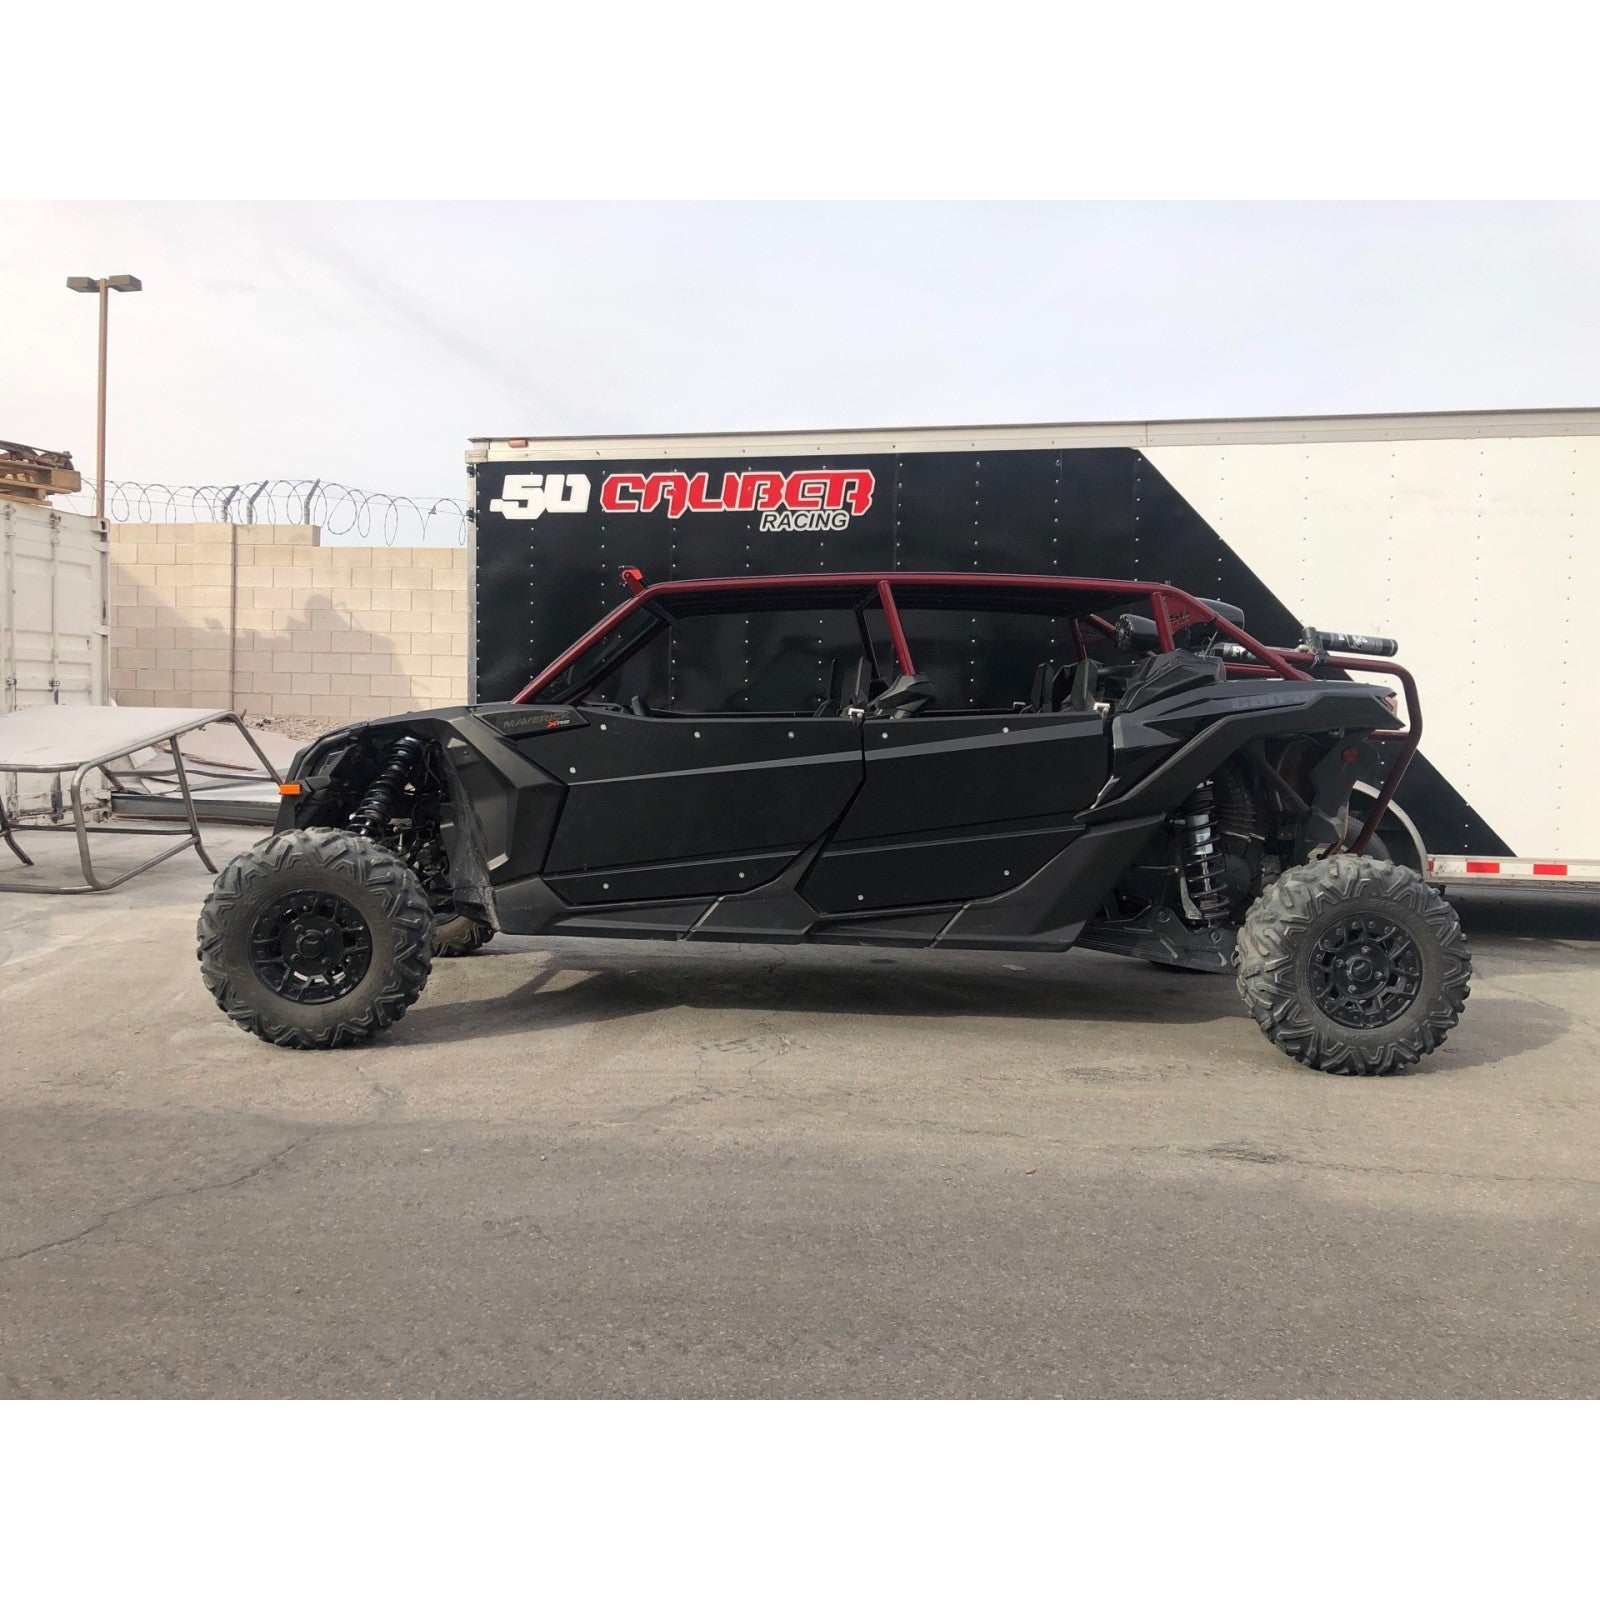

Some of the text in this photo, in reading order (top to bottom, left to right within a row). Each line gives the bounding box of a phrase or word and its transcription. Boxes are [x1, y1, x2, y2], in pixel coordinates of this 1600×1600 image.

[490, 470, 875, 519] .50 CALIBER
[760, 511, 850, 531] RACING
[504, 711, 570, 728] MAVERICK
